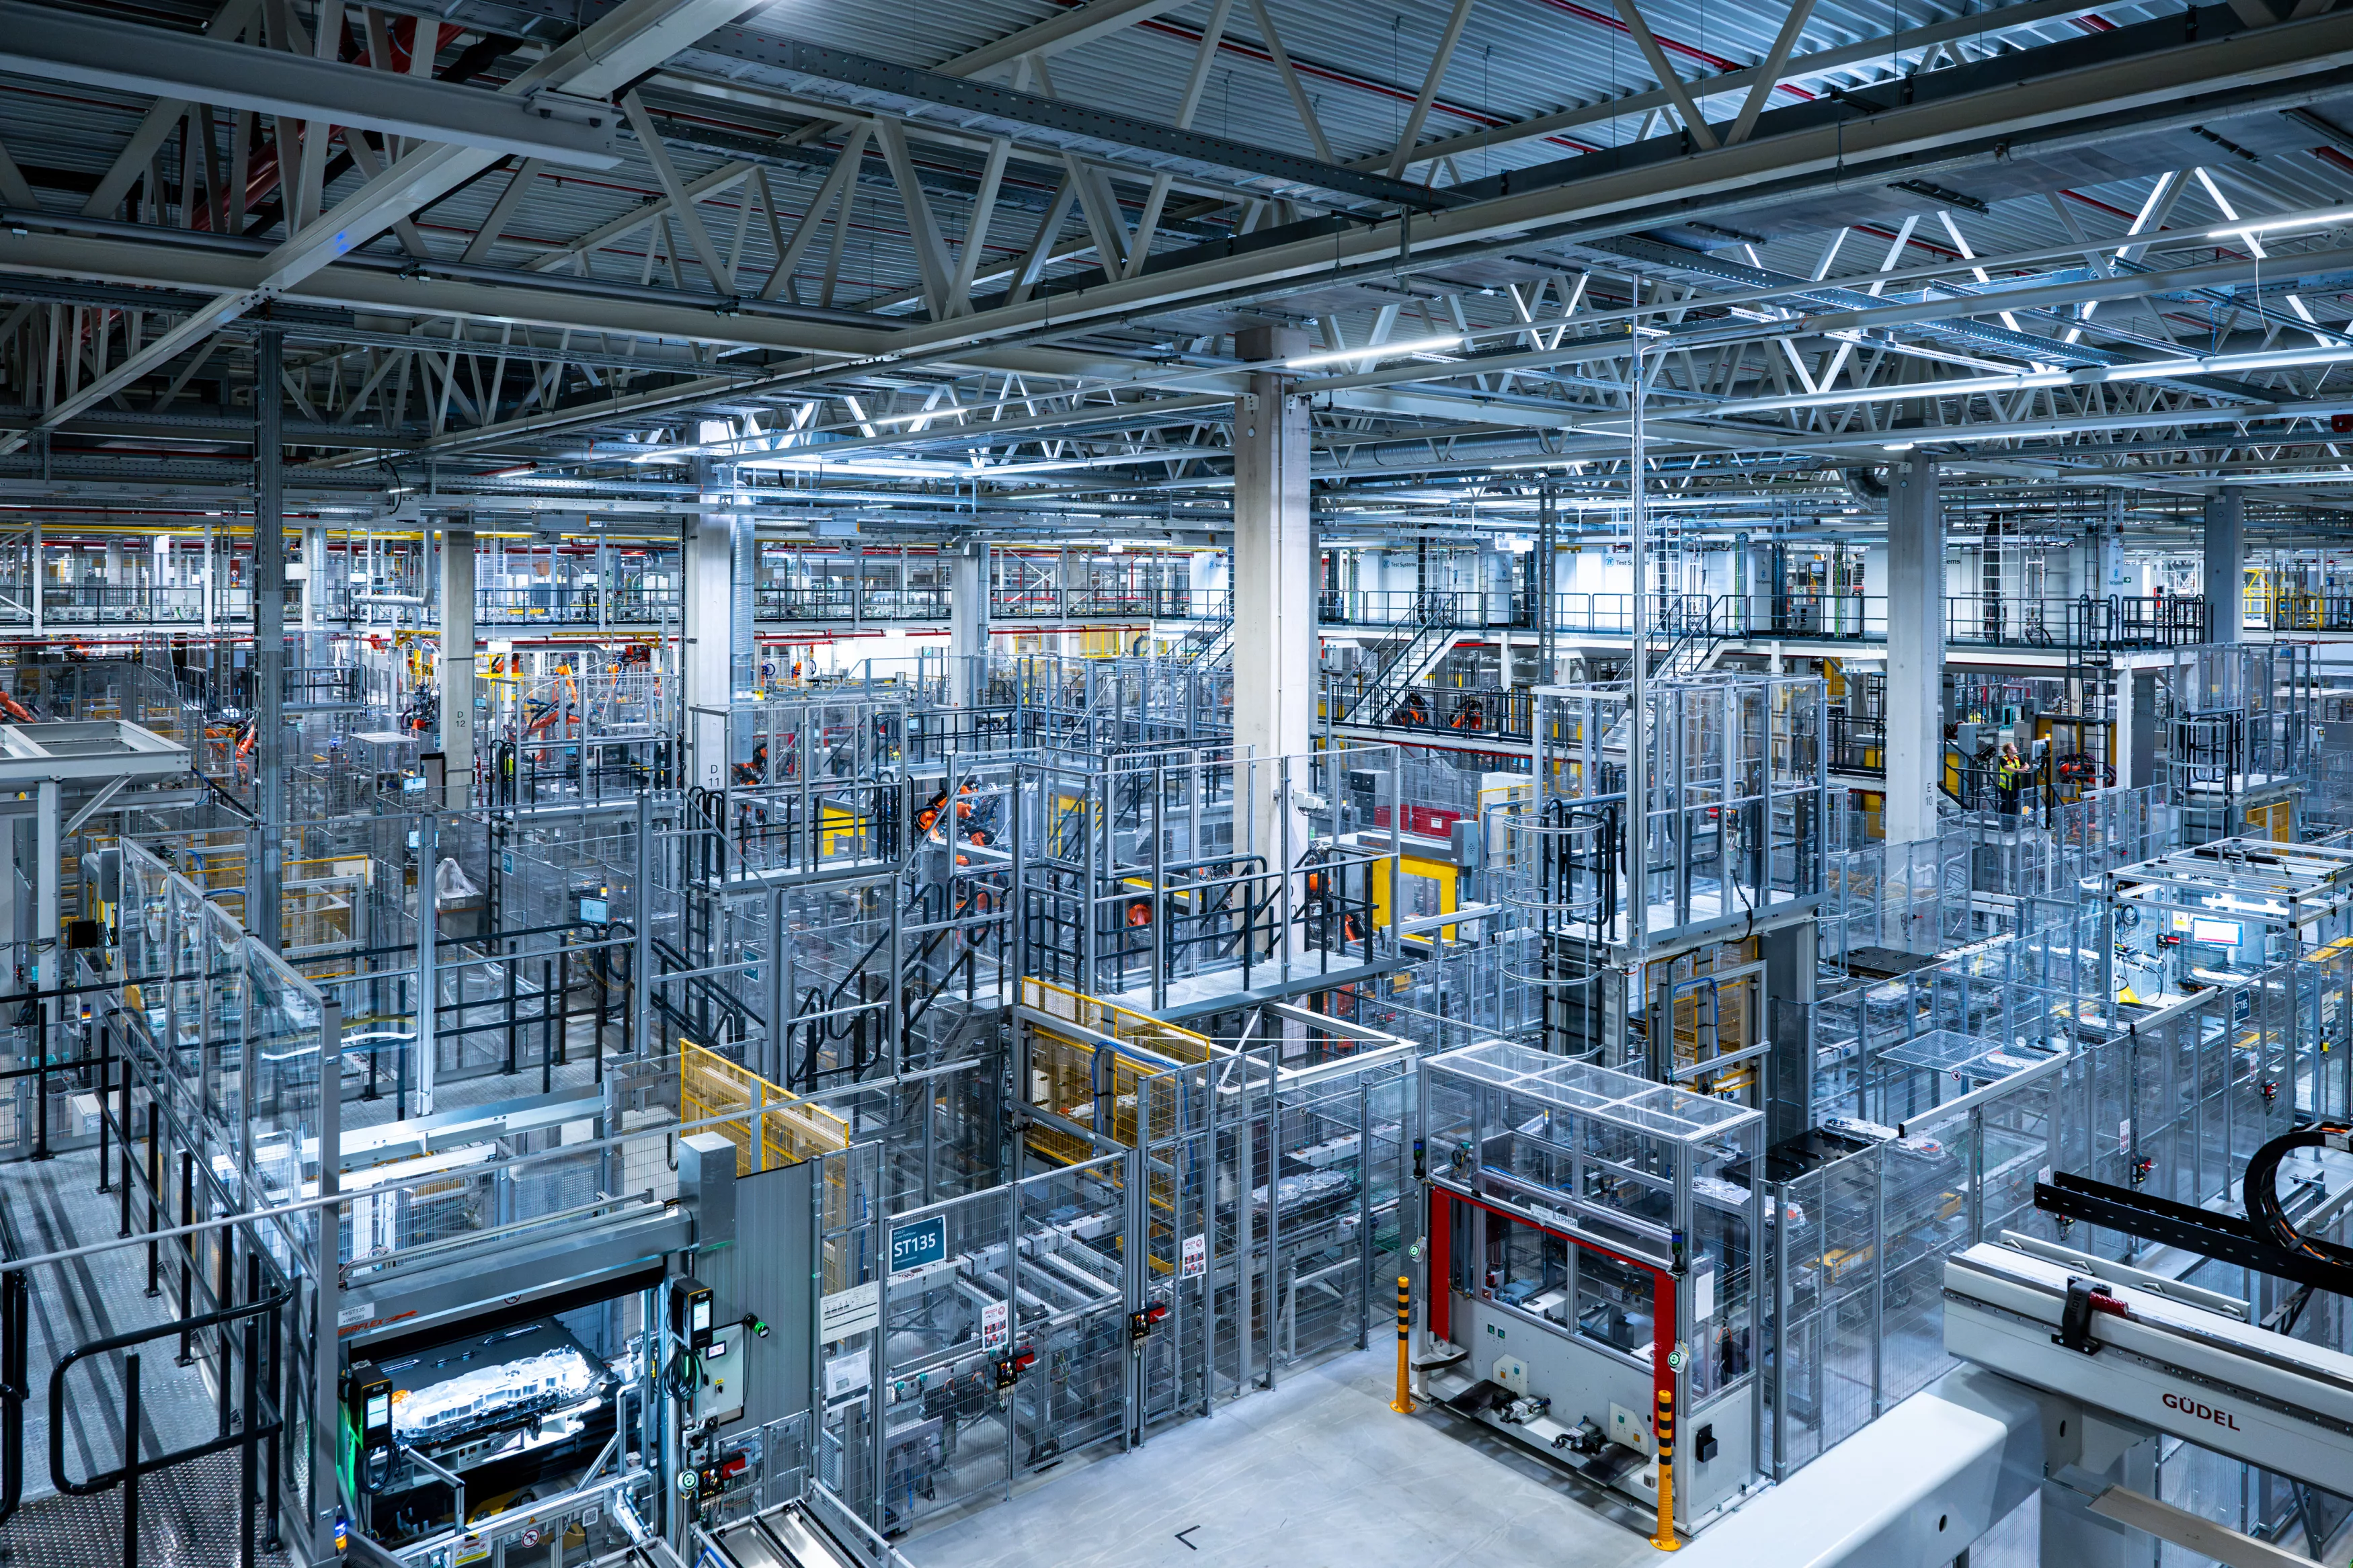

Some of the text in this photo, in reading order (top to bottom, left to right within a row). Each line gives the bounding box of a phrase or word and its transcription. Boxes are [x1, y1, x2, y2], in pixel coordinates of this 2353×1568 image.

[711, 764, 718, 774] D
[709, 777, 719, 787] 11
[1927, 782, 1931, 792] E
[1925, 796, 1933, 806] 10
[1554, 1213, 1577, 1227] L1PH04
[894, 1232, 936, 1257] ST135
[2162, 1393, 2241, 1432] GÜDEL
